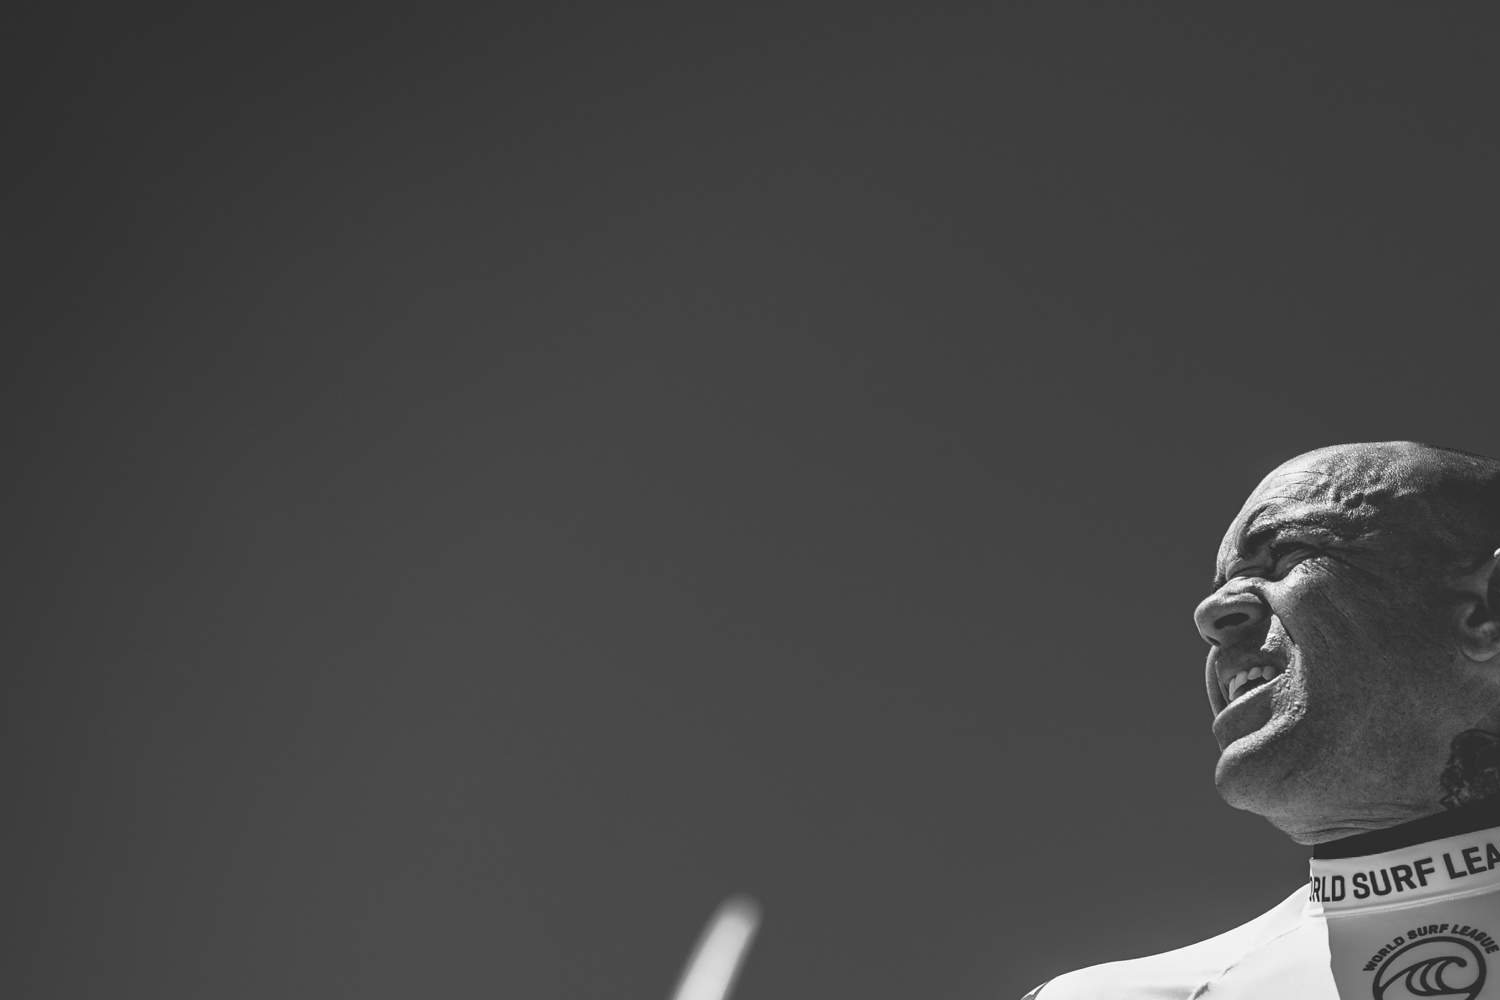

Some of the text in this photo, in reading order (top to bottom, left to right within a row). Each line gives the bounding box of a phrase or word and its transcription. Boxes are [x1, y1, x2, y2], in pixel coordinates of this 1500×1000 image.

[1352, 857, 1435, 899] SURF
[1363, 924, 1500, 972] WORLD SURF LEAGUE
